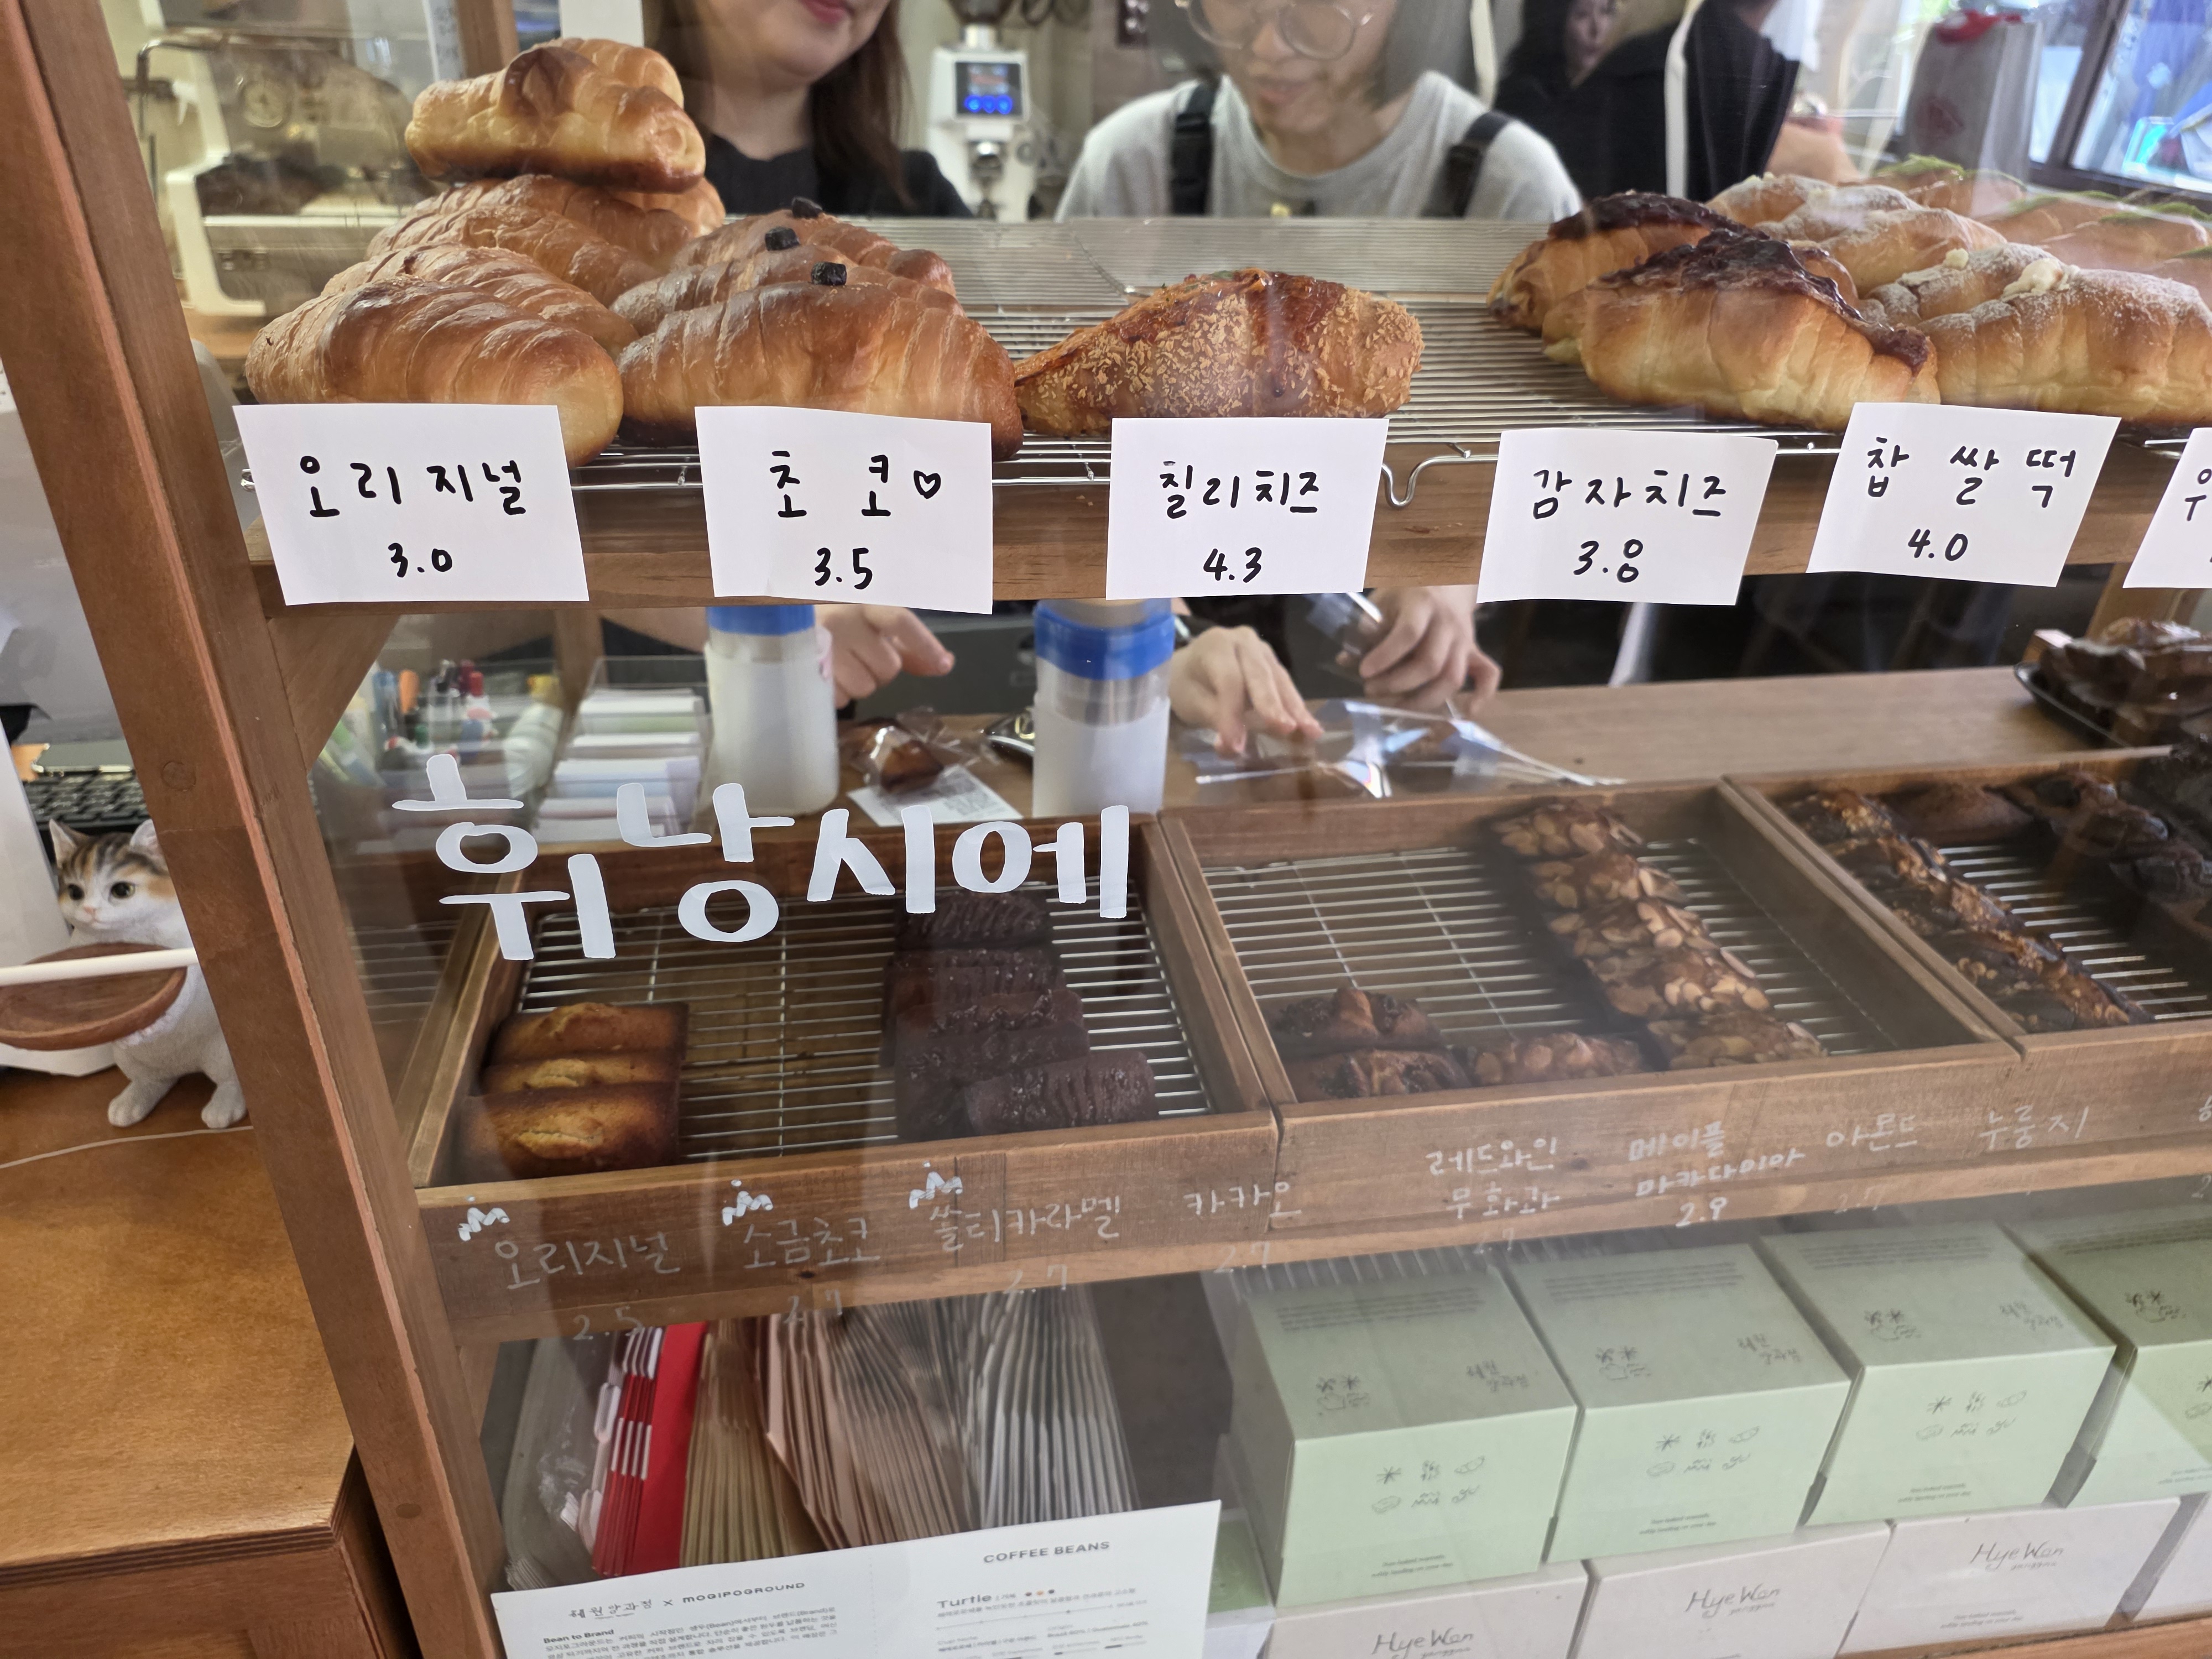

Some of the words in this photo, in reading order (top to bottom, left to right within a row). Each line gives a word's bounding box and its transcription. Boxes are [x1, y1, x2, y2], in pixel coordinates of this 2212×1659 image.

[300, 455, 526, 517] 오리지널
[1160, 461, 1319, 519] 칠리치즈
[1866, 437, 2077, 508] 찹쌀떡
[1532, 469, 1726, 519] 감자치즈
[388, 542, 453, 578] 3.0
[1203, 547, 1262, 583] 4.3
[1573, 539, 1644, 583] 3.8
[1907, 529, 1969, 561] 4.0
[815, 547, 873, 589] 3.5
[392, 753, 1130, 961] 휘낭시에
[1628, 1120, 1725, 1162] 메이플
[1826, 1112, 1918, 1152] 아몬드
[1979, 1106, 2089, 1151] 누룽지
[1425, 1136, 1558, 1176] 레드와인
[1635, 1147, 1807, 1197] 마카다미아
[1183, 1181, 1302, 1218] 카카오
[1446, 1181, 1561, 1220] 무화과
[1675, 1196, 1728, 1228] 2.9
[494, 1231, 681, 1290] 오리지널
[743, 1217, 881, 1269] 소금초코
[1213, 1241, 1270, 1274] 2.7
[983, 1546, 1049, 1564] COFFEE
[1054, 1541, 1110, 1556] BEANS
[936, 1594, 992, 1609] Turtle
